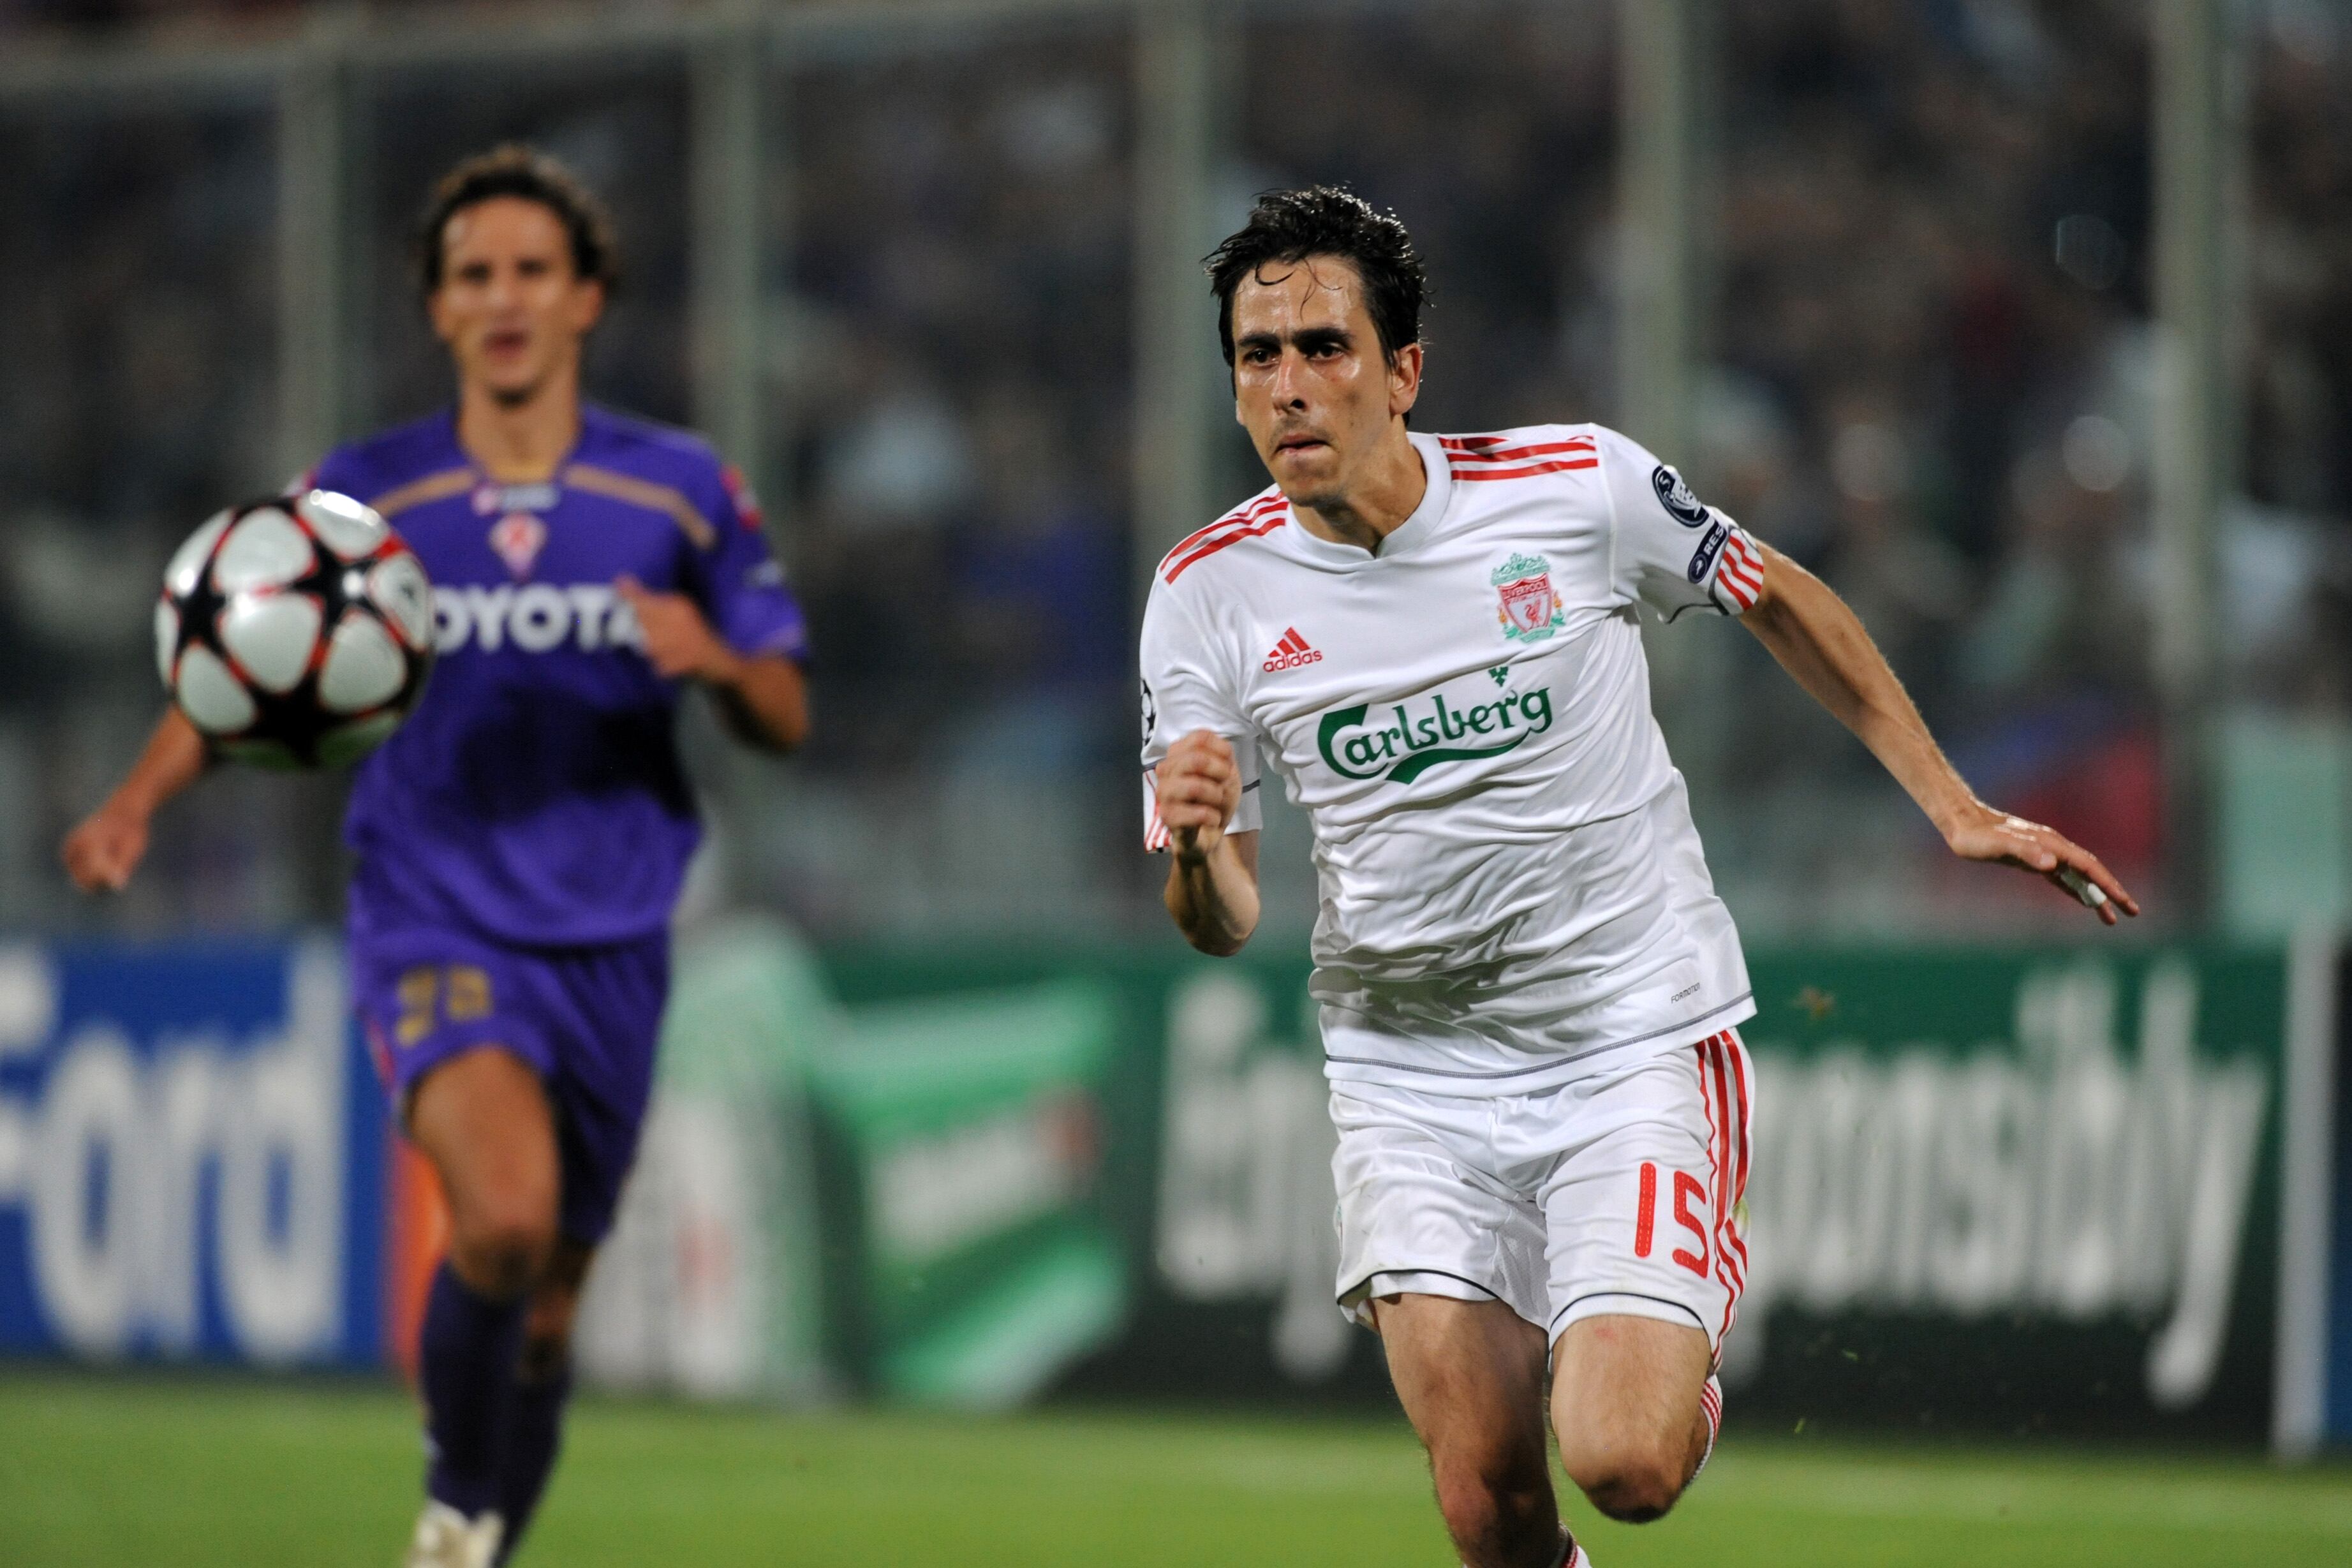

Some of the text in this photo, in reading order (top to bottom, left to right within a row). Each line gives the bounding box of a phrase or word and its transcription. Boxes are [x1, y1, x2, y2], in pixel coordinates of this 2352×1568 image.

[435, 582, 649, 655] OYOTA
[1263, 650, 1322, 673] adidas
[1317, 686, 1553, 785] Carlsberg
[1671, 982, 1701, 1004] FORMOTION
[1156, 970, 1346, 1381] Enj
[1634, 1162, 1710, 1280] 15
